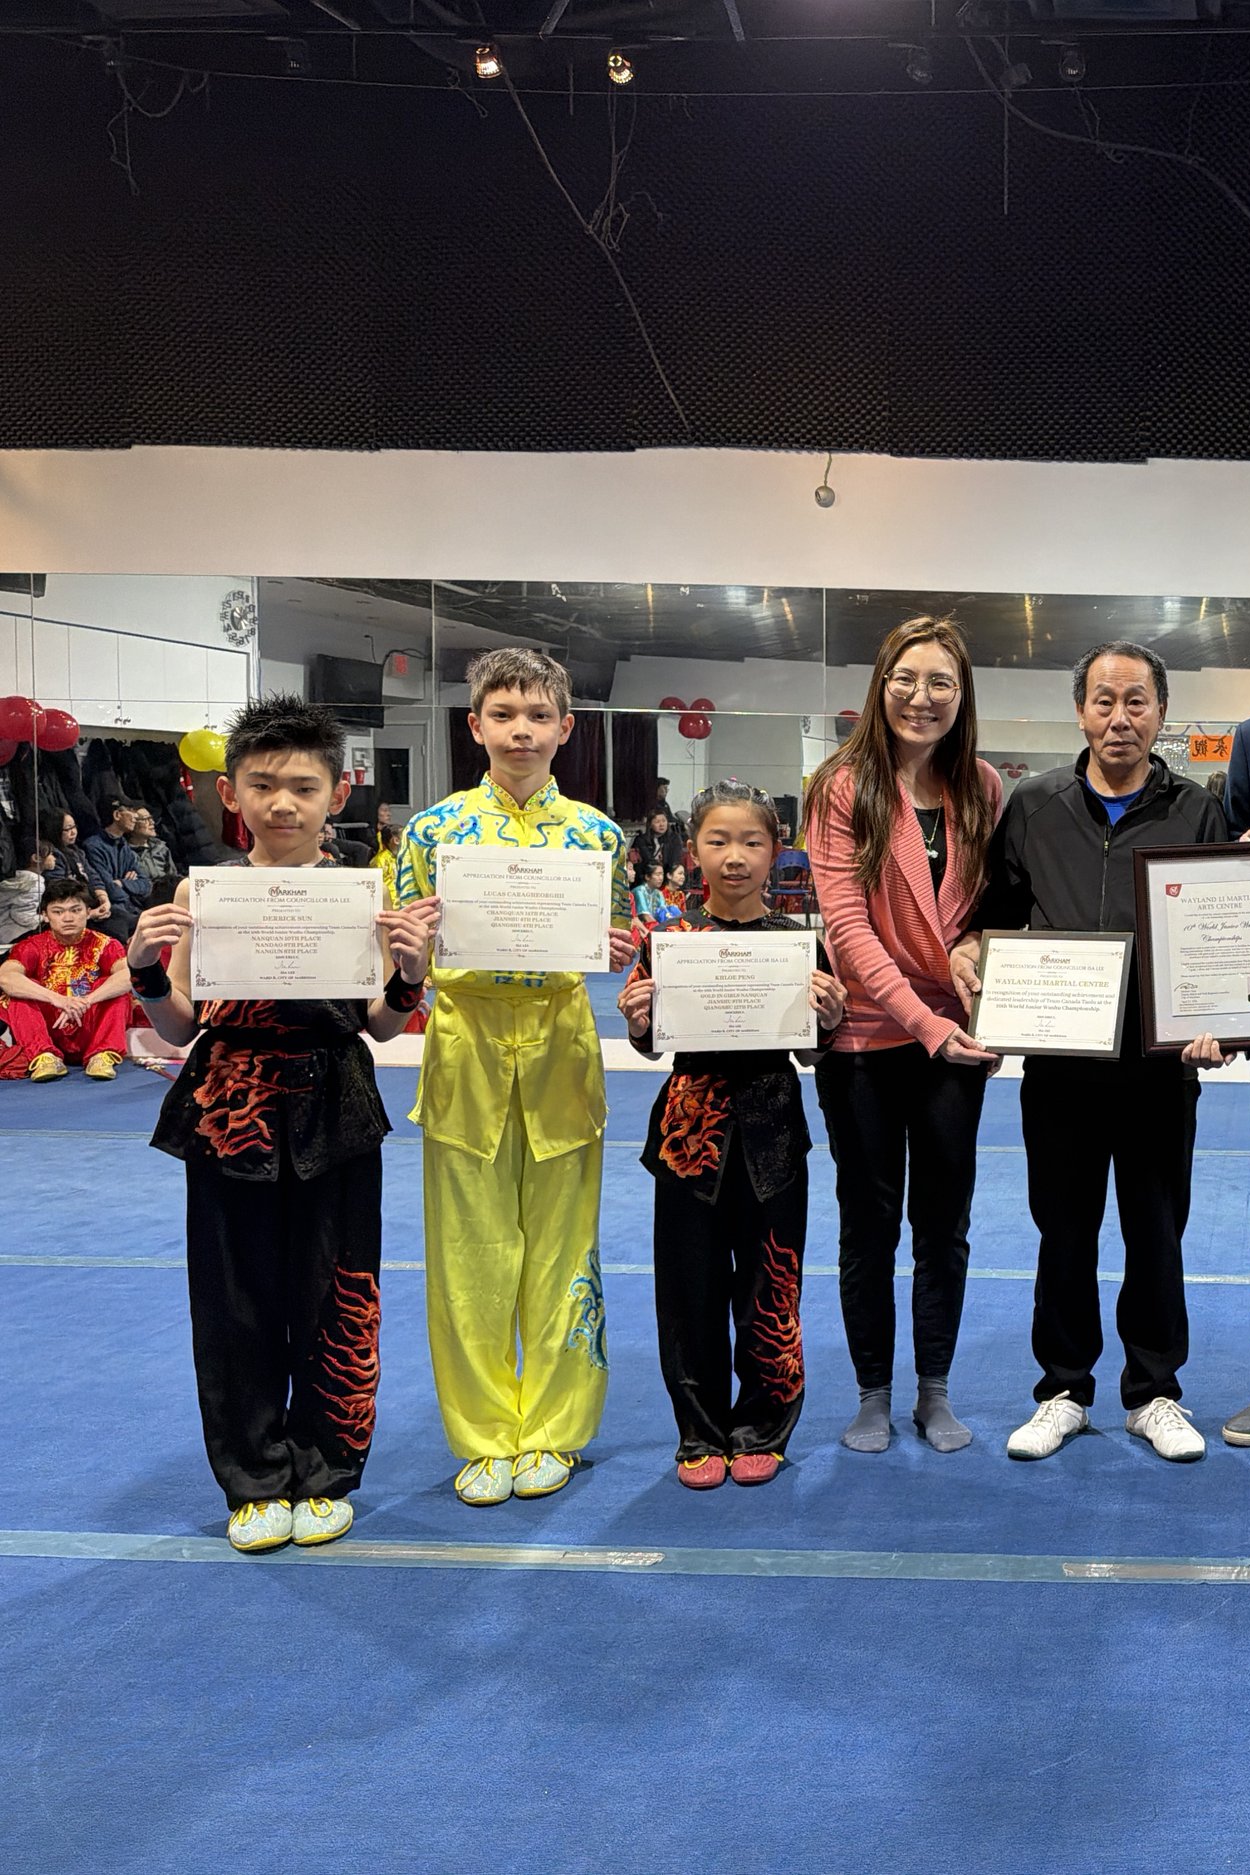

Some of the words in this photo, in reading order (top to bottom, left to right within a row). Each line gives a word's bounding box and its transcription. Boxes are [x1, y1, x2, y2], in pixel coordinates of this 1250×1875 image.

[508, 864, 542, 874] MARKHAM
[268, 886, 307, 897] MARKHAM
[719, 949, 751, 958] MARKHAM
